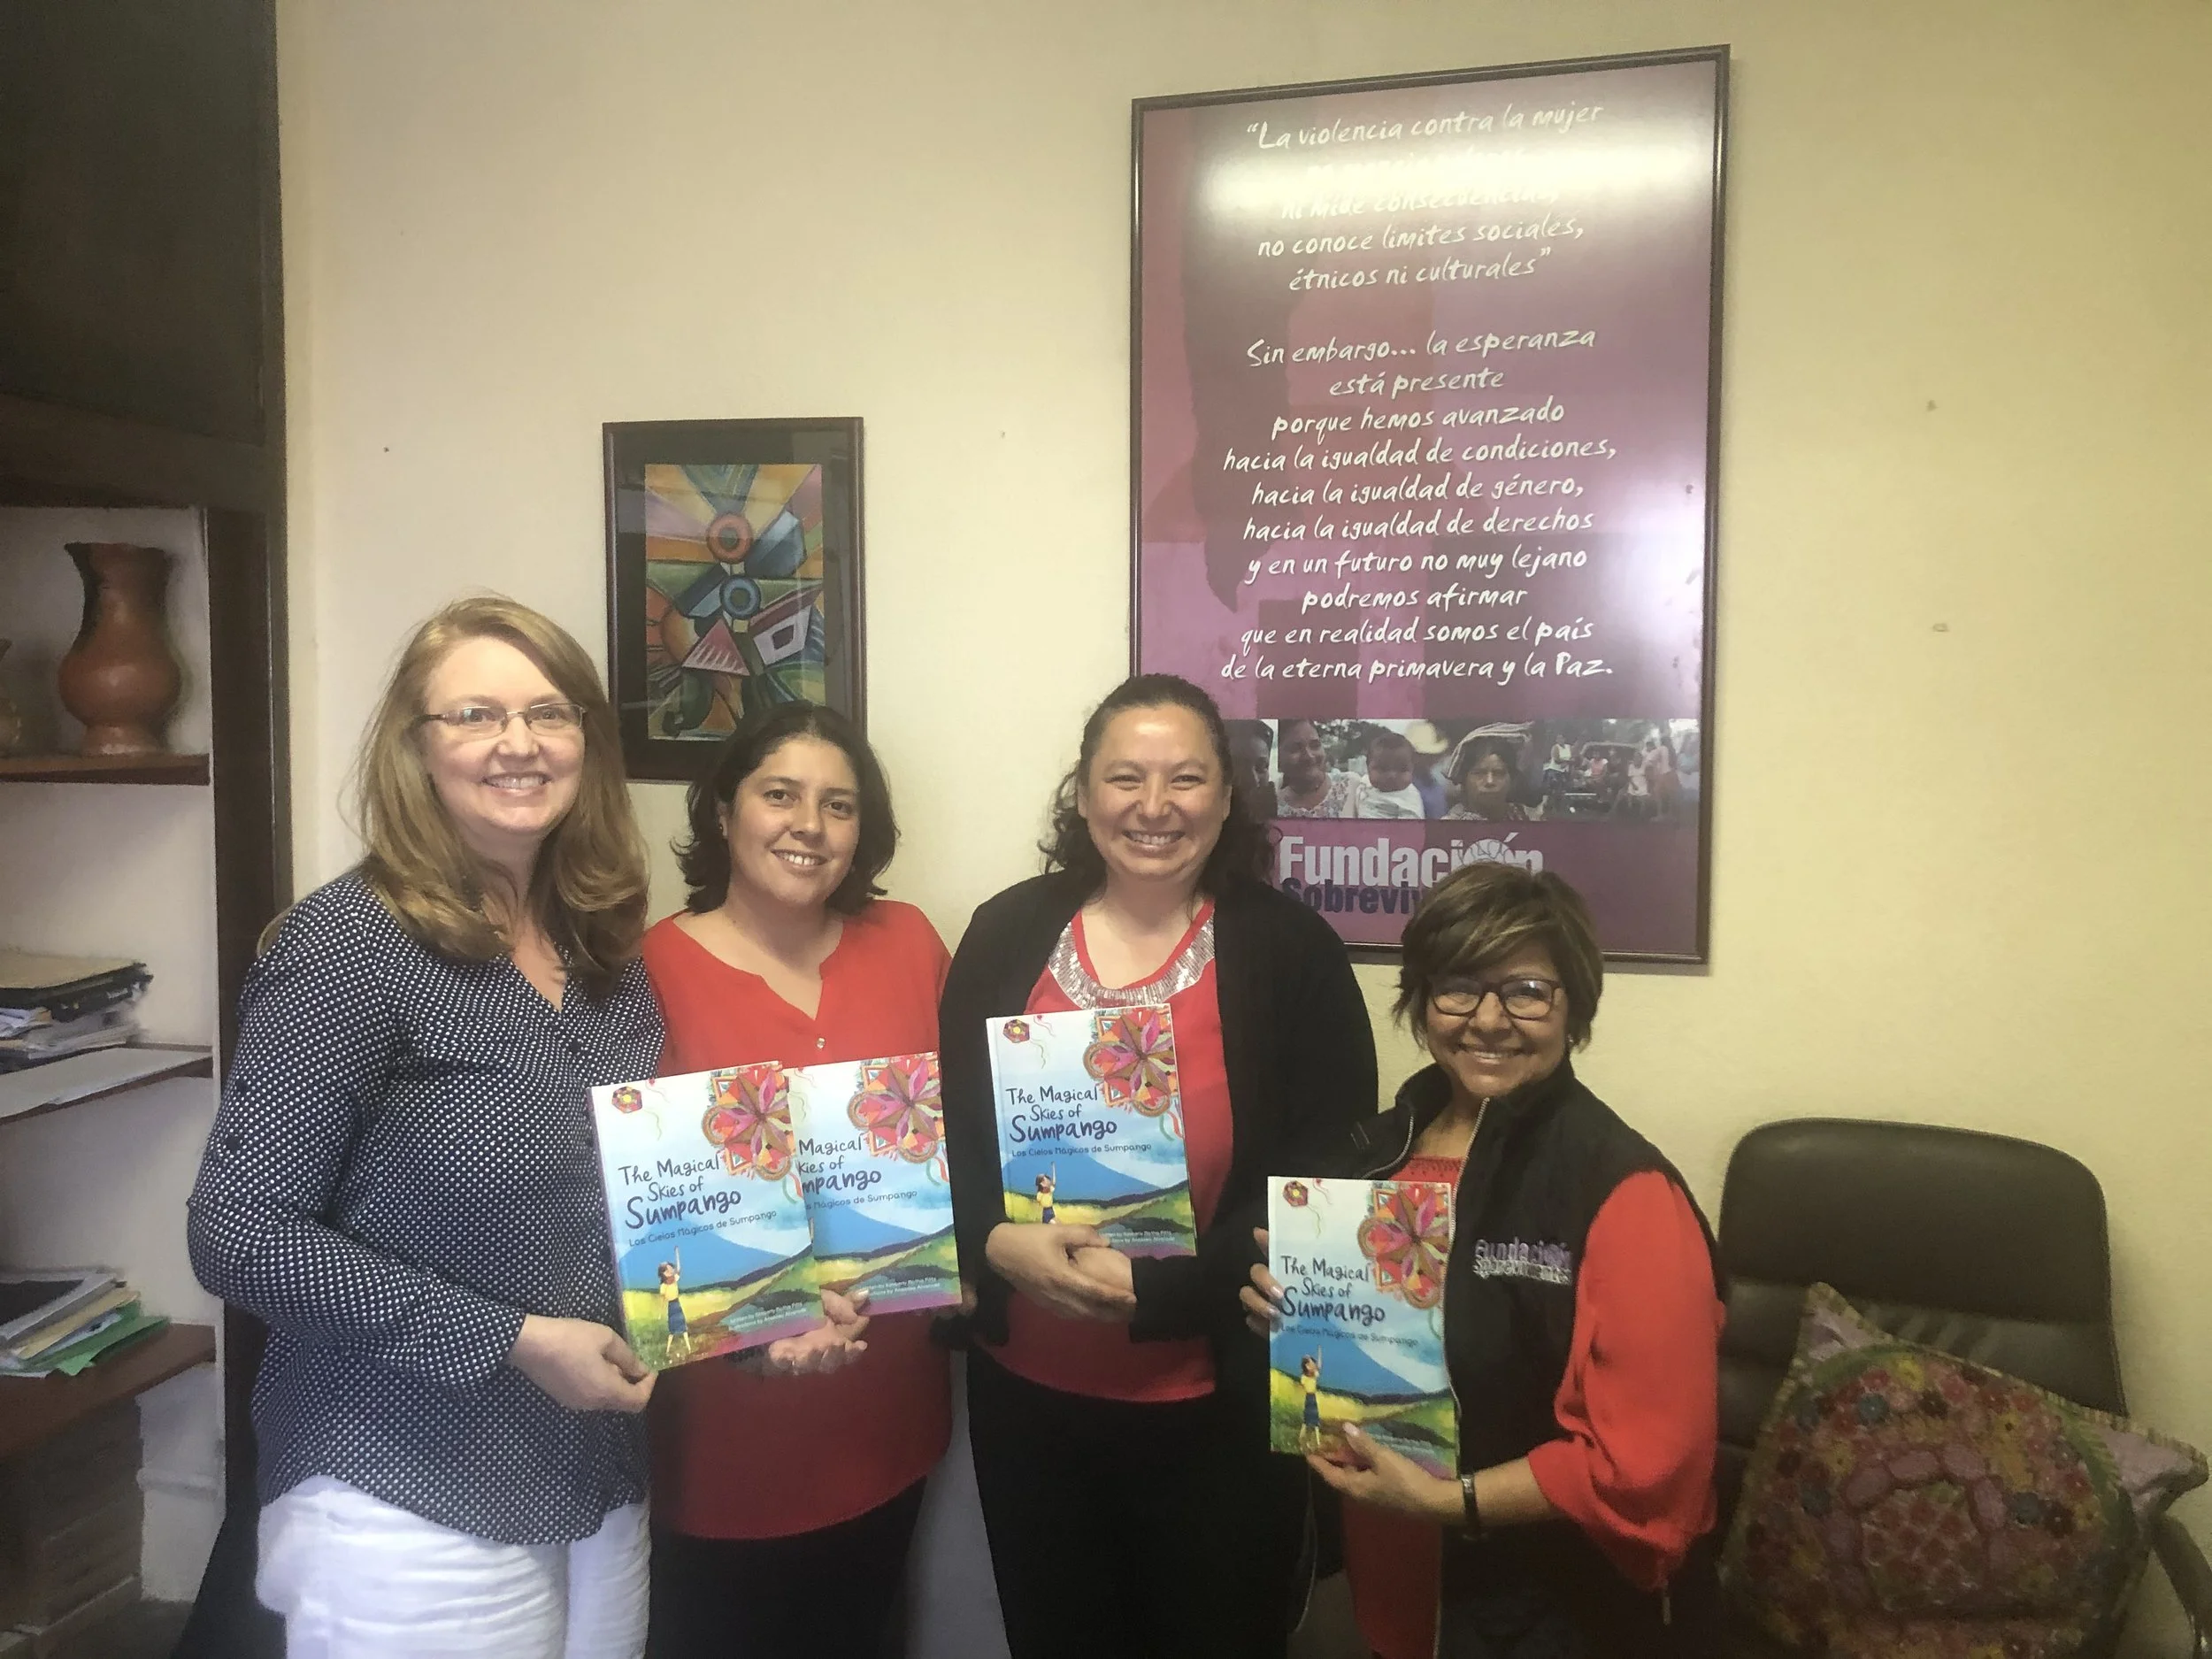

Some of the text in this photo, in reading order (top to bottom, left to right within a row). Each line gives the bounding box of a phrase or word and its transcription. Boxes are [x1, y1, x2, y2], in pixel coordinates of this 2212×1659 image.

[1300, 119, 1402, 144] violencia
[1411, 111, 1493, 134] contra
[1503, 104, 1525, 127] la
[1534, 102, 1604, 129] mujer
[1258, 241, 1284, 257] no
[1293, 235, 1372, 254] conoce
[1473, 215, 1583, 241] sociales,
[1289, 268, 1379, 290] étnicos
[1386, 266, 1408, 284] ni
[1247, 330, 1595, 366] Sin embargo... la esperanza
[1330, 367, 1503, 399] está presente
[1271, 396, 1564, 446] porque hemos avanzado
[1224, 433, 1616, 472] hacia la igualdad de condiciones,
[1252, 471, 1583, 506] hacia la igualdad de género,
[1243, 506, 1594, 541] hacia la igualdad de derechos
[1244, 543, 1586, 584] y en un futuro no muy lejano
[1302, 581, 1528, 615] podremos afirmar
[1240, 616, 1594, 655] que en realidad somos el país
[1221, 651, 1613, 686] de la eterna primavera y la Paz.
[1006, 1086, 1098, 1105] The Magical
[1030, 1103, 1082, 1121] Skies of
[1010, 1115, 1118, 1143] Sumpango
[798, 1136, 862, 1156] Magical
[1104, 1143, 1152, 1154] Sumpango
[618, 1154, 719, 1186] The Magical
[798, 1155, 844, 1175] kies of
[647, 1176, 703, 1202] Skies of
[802, 1170, 881, 1194] mpango
[854, 1195, 864, 1204] de
[867, 1190, 917, 1202] Sumpango
[625, 1190, 741, 1229] Sumpango
[629, 1237, 646, 1247] Los
[649, 1231, 675, 1243] Cielos
[729, 1210, 777, 1227] Sumpango
[1280, 1255, 1370, 1282] The Magical
[1302, 1277, 1353, 1298] Skies of
[1283, 1286, 1386, 1326] Sumpango
